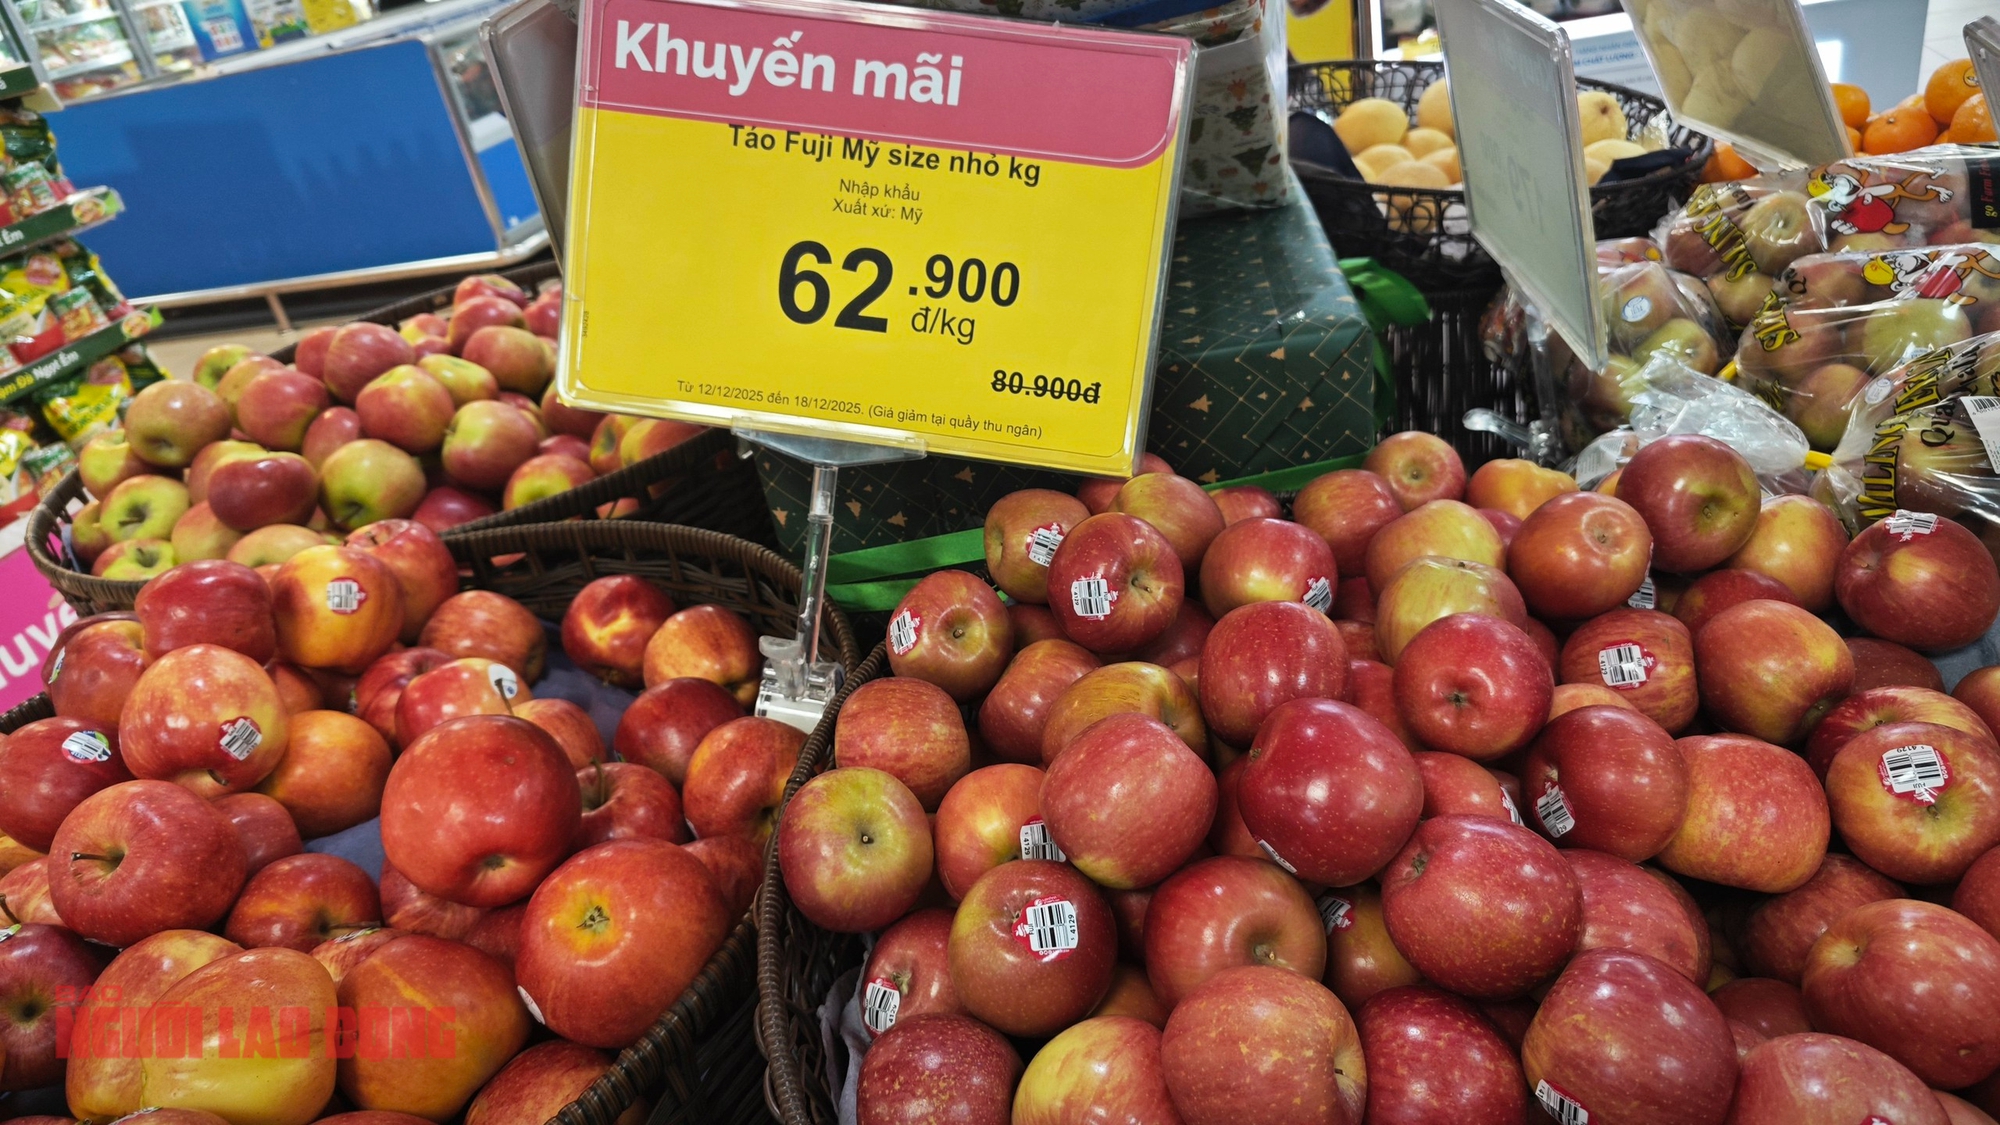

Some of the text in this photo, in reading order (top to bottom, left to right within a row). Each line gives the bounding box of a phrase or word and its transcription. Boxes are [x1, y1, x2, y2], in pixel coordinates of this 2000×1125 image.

[616, 20, 964, 106] Khuyến mãi
[729, 123, 1041, 188] Táo Fuji Mỹ size nhỏ kg
[839, 178, 920, 202] Nhập khẩu
[833, 198, 923, 224] Xuất xứ: Mỹ
[778, 241, 1020, 334] 62 .900
[911, 306, 975, 345] đ/kg
[990, 369, 1102, 405] 80.900đ
[677, 380, 695, 394] Từ
[699, 383, 764, 402] 12/12/2025
[766, 389, 790, 404] đến
[868, 403, 894, 421] (Giá
[896, 406, 928, 426] giảm
[930, 409, 947, 425] tại
[949, 411, 981, 432] quầy
[983, 418, 1003, 433] thu
[1005, 421, 1042, 440] ngân)
[1023, 837, 1031, 856] 4129
[1067, 914, 1077, 934] 4129
